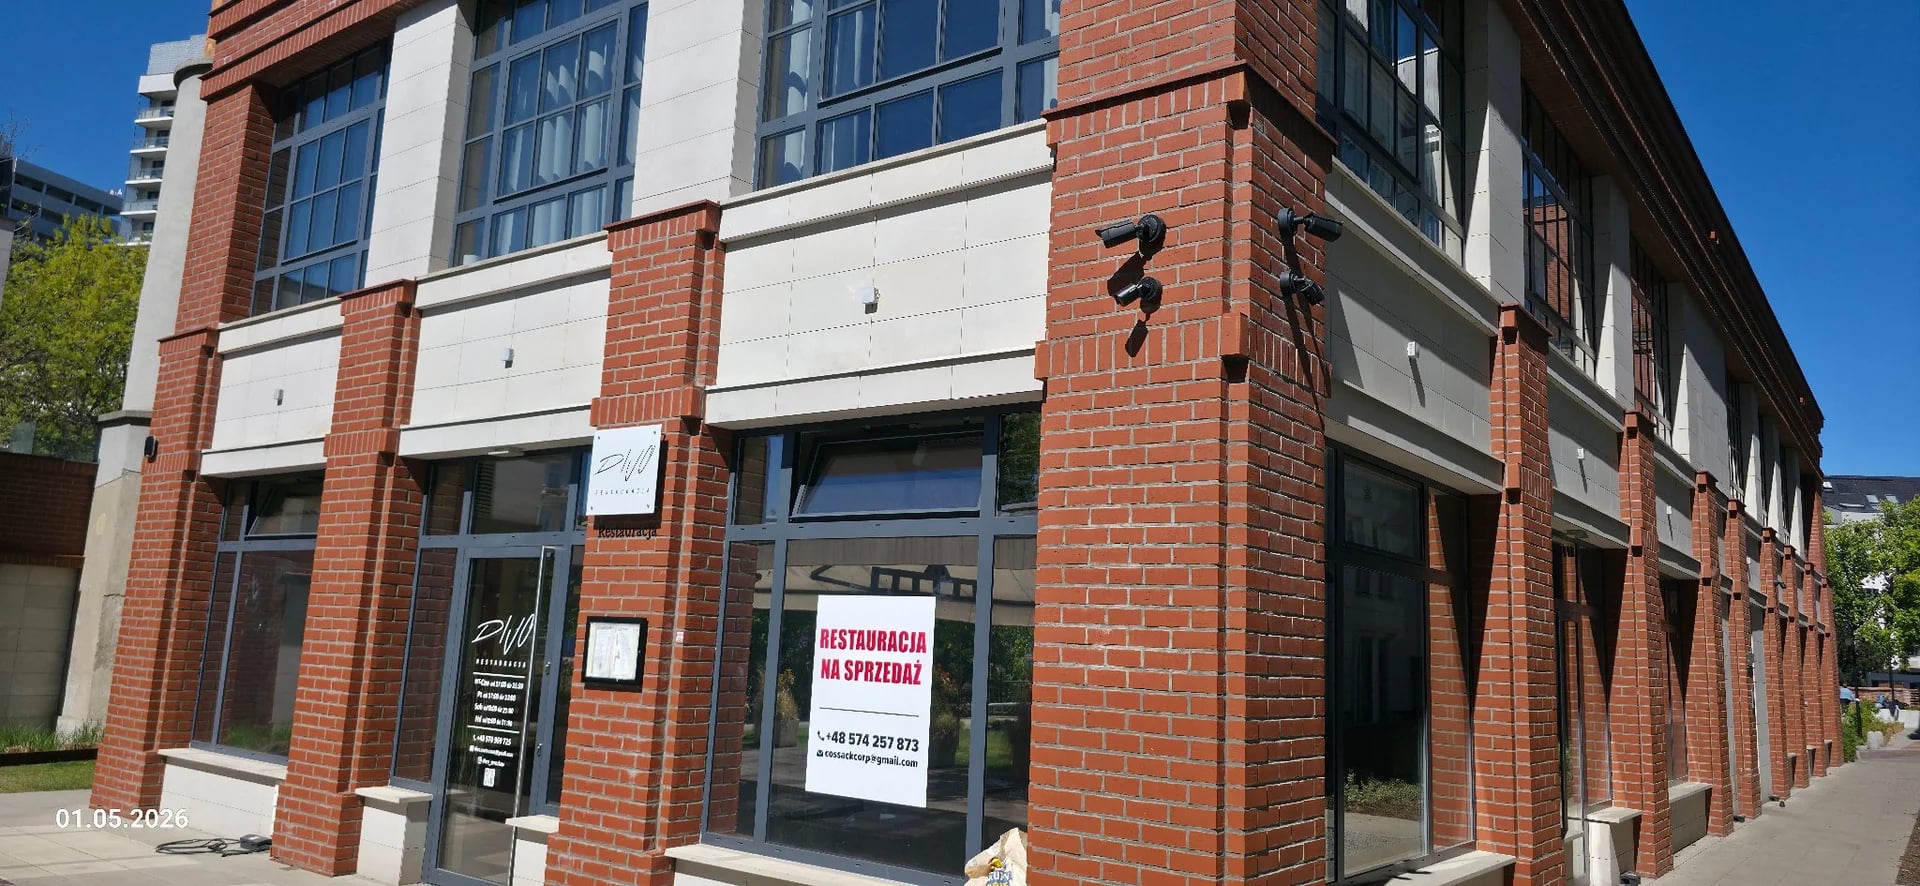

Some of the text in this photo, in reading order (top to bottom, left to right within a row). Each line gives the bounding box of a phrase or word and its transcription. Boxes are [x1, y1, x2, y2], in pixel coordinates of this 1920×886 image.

[598, 528, 657, 540] Restauracja
[820, 628, 927, 653] RESTAURACJA
[476, 658, 526, 669] RESTAURACJA
[820, 658, 922, 686] NA SPRZEDAŻ
[826, 731, 920, 752] +48 574 257 873
[824, 750, 919, 768] cossackcorp@gmail.com
